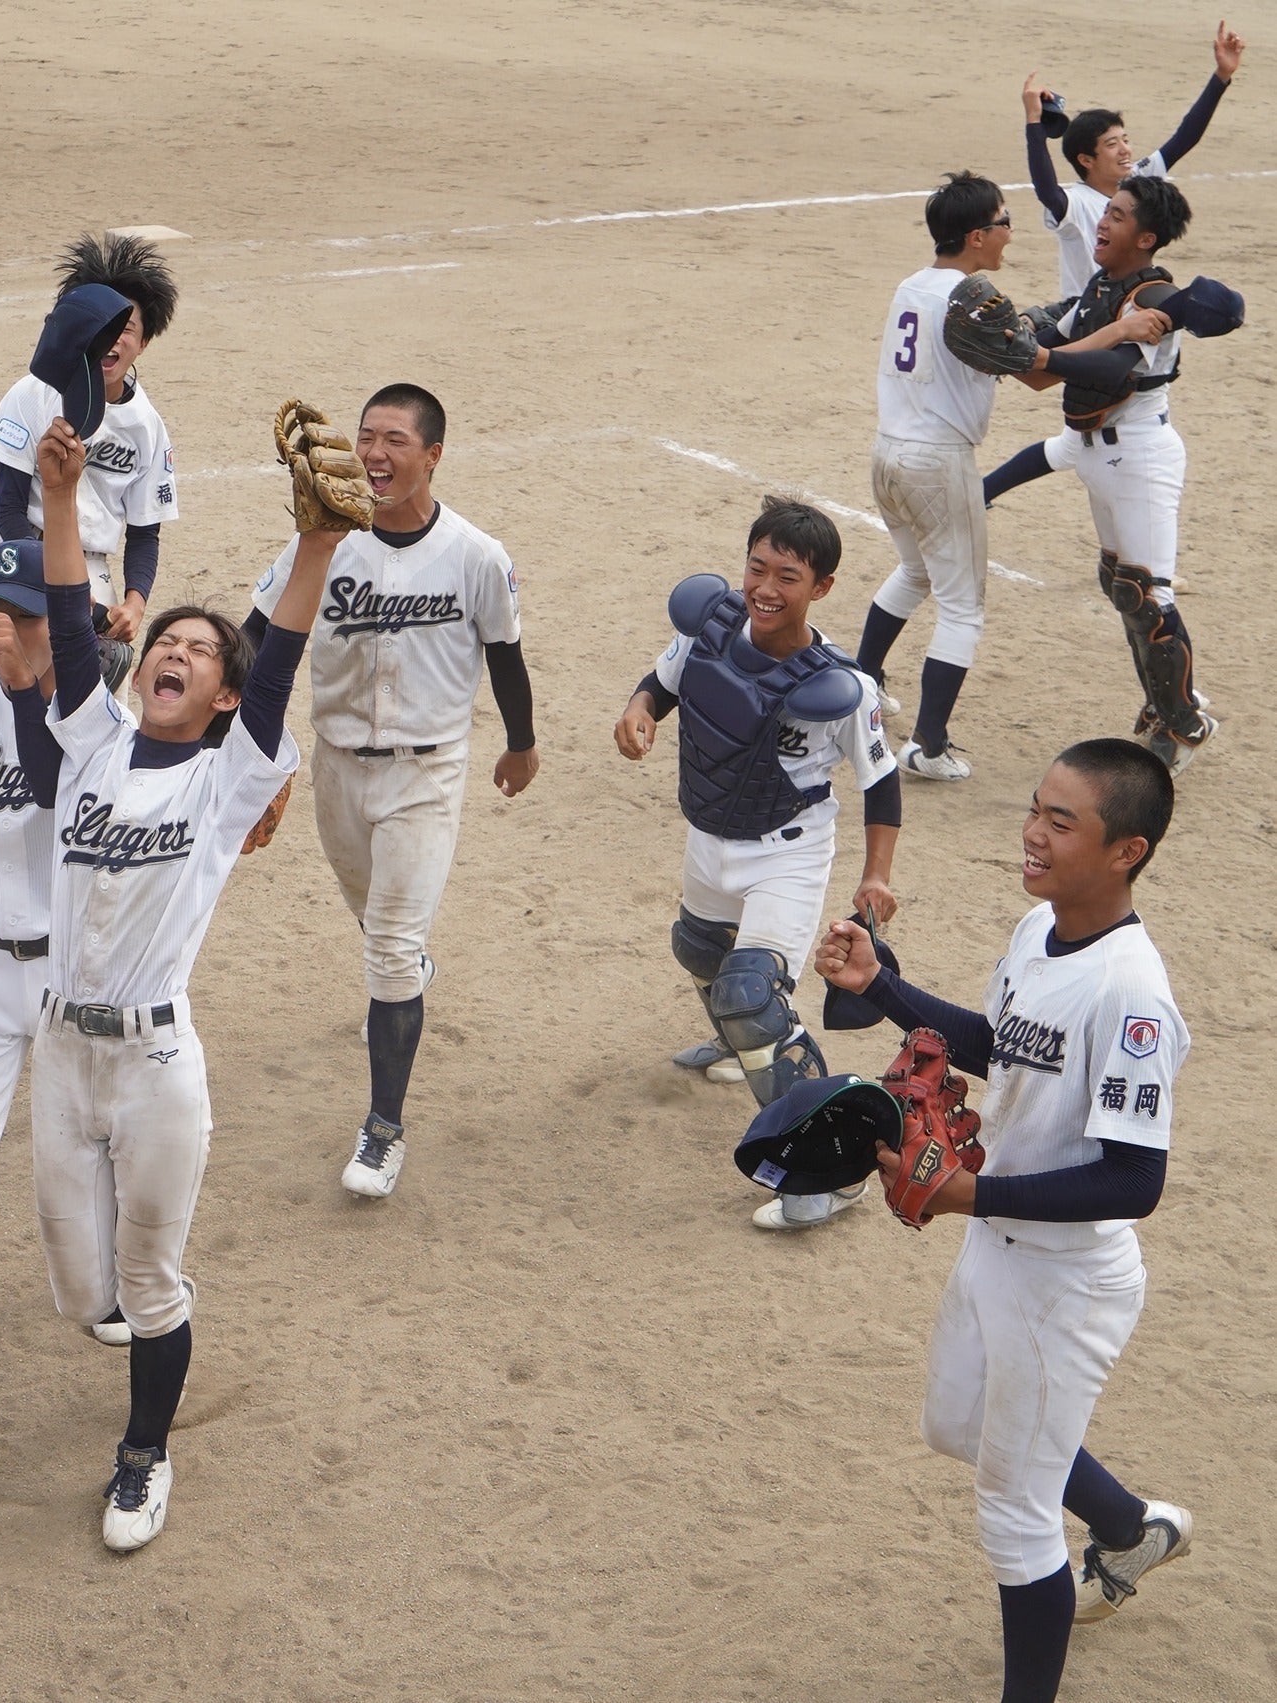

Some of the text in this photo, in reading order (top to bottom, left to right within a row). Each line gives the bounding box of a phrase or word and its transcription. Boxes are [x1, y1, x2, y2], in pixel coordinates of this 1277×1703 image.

[895, 310, 918, 373] 3
[0, 547, 17, 575] S
[323, 576, 464, 643] Sluggers
[1099, 1076, 1161, 1118] 福岡
[915, 1140, 941, 1181] ZETT
